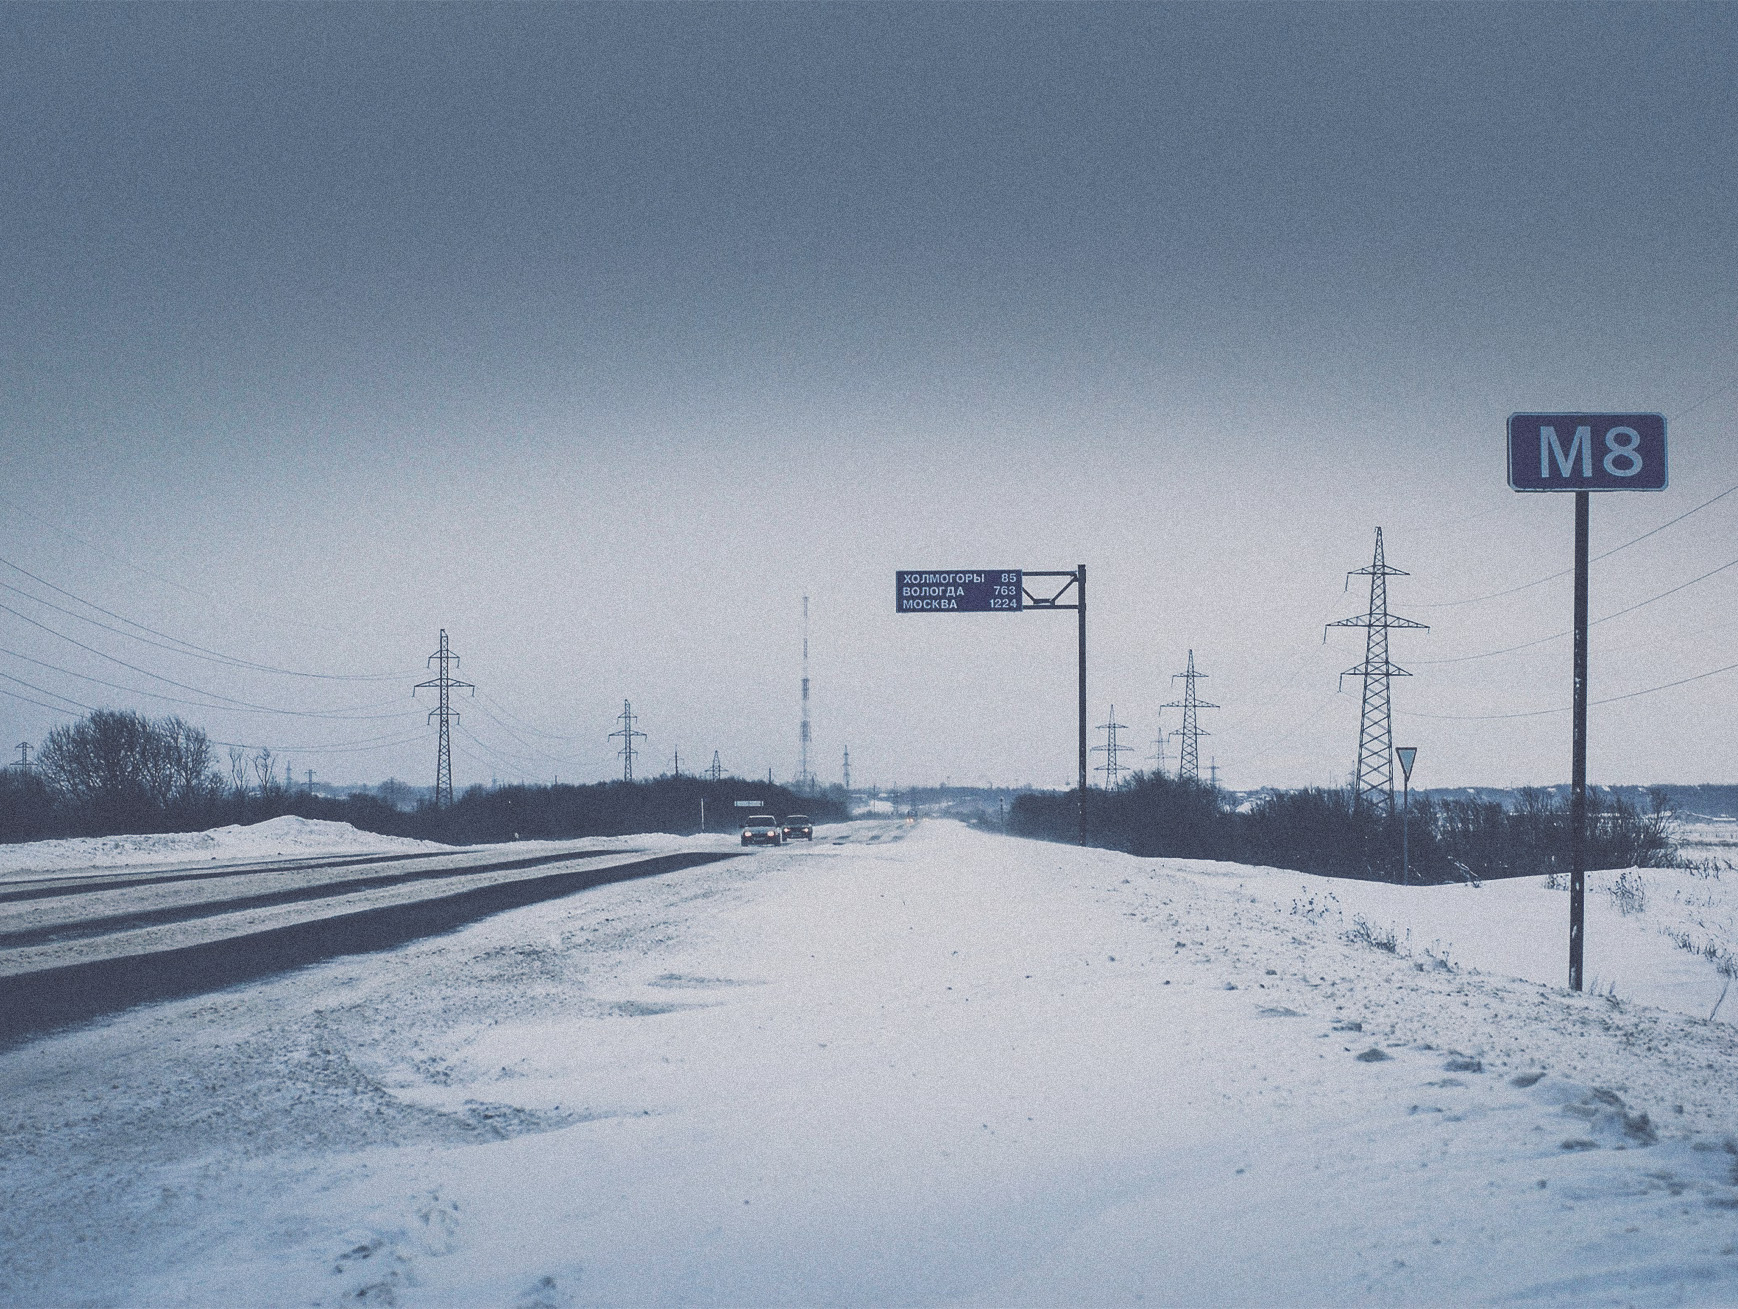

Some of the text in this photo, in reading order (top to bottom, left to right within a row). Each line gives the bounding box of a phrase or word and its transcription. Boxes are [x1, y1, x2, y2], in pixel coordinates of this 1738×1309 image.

[903, 573, 1017, 583] ХОЛМОГОРЫ 85
[902, 585, 1016, 597] ВОЛОГДА 763
[902, 598, 1018, 609] МОСКВА 1224
